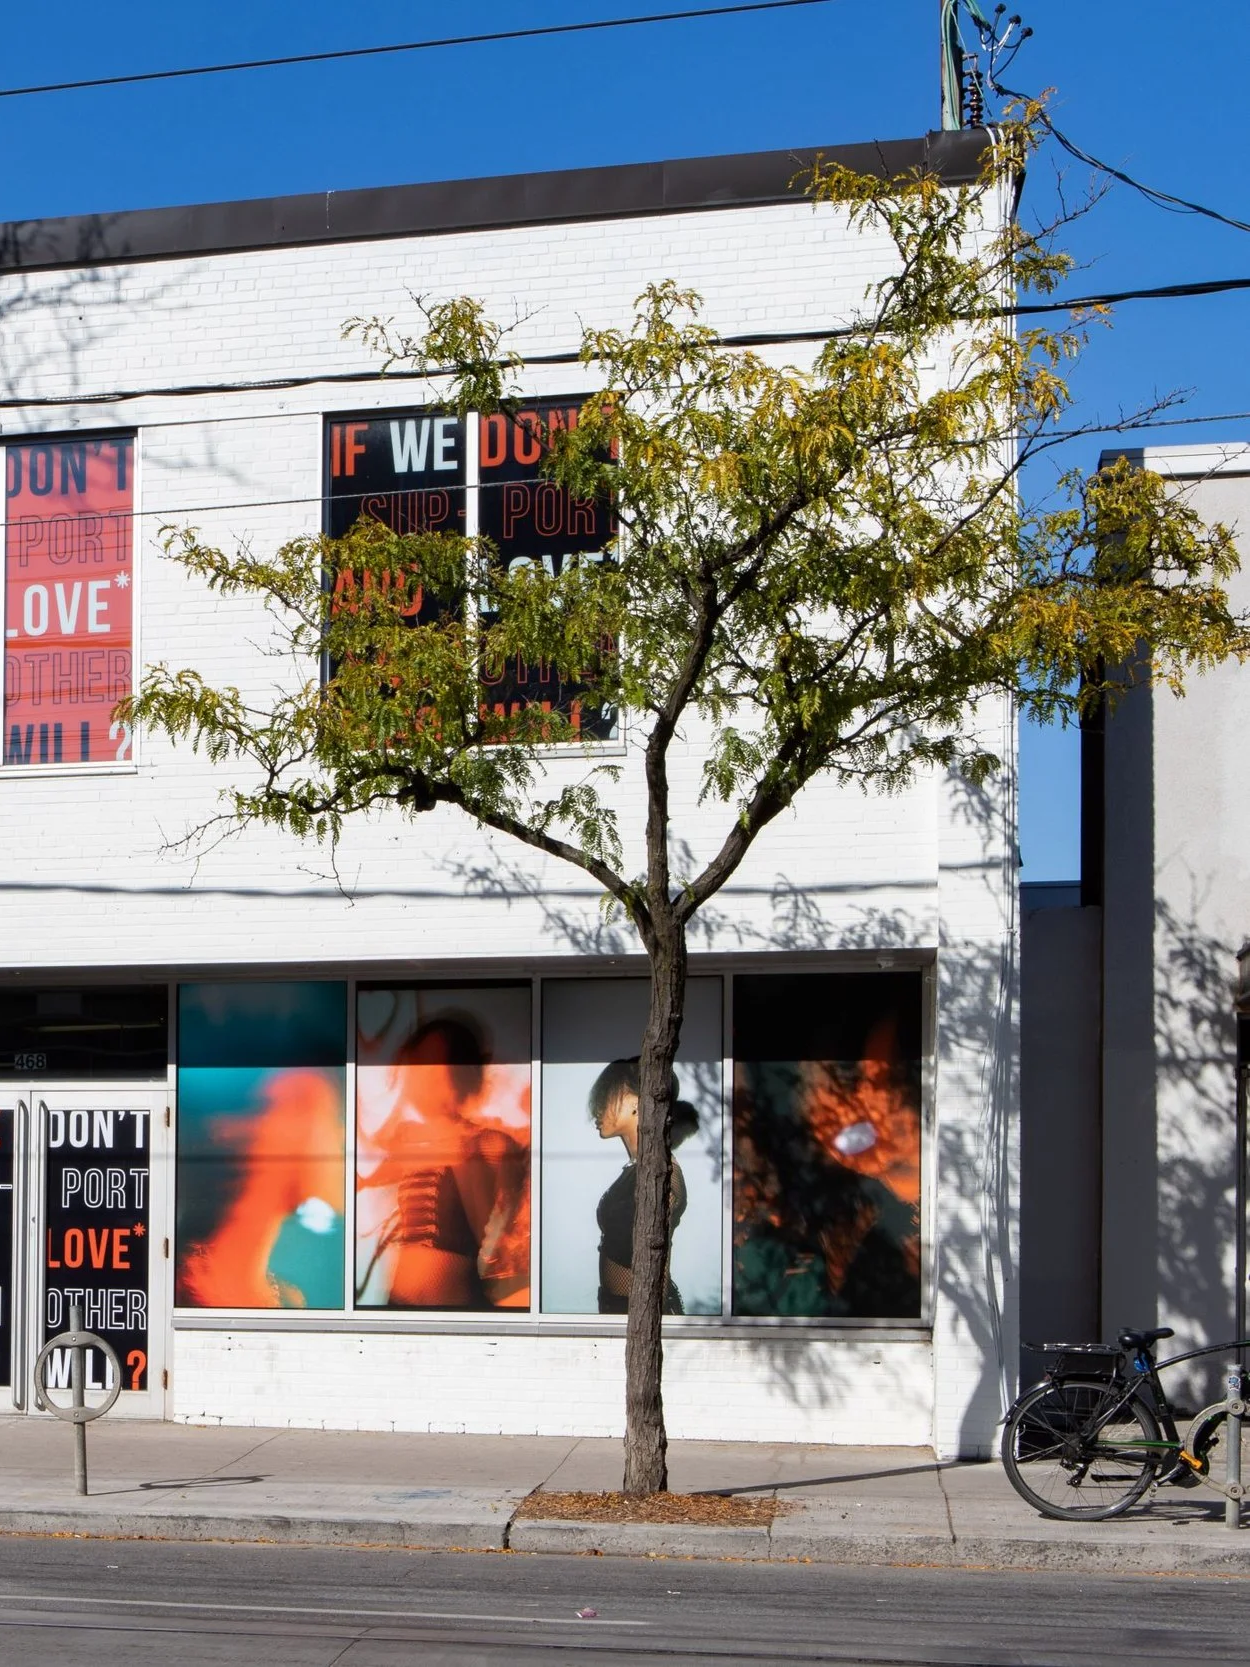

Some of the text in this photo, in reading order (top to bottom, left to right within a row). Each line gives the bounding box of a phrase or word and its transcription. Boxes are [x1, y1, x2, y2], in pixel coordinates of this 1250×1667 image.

[6, 438, 132, 498] DON'T
[331, 423, 369, 477] IF
[389, 418, 458, 473] WE
[20, 509, 132, 567] PORT
[503, 482, 619, 538] POR
[6, 649, 132, 707] OTHER
[15, 1054, 45, 1069] 468
[48, 1110, 149, 1148] DON'T
[62, 1168, 149, 1208] PORT
[47, 1288, 147, 1330] OTHER
